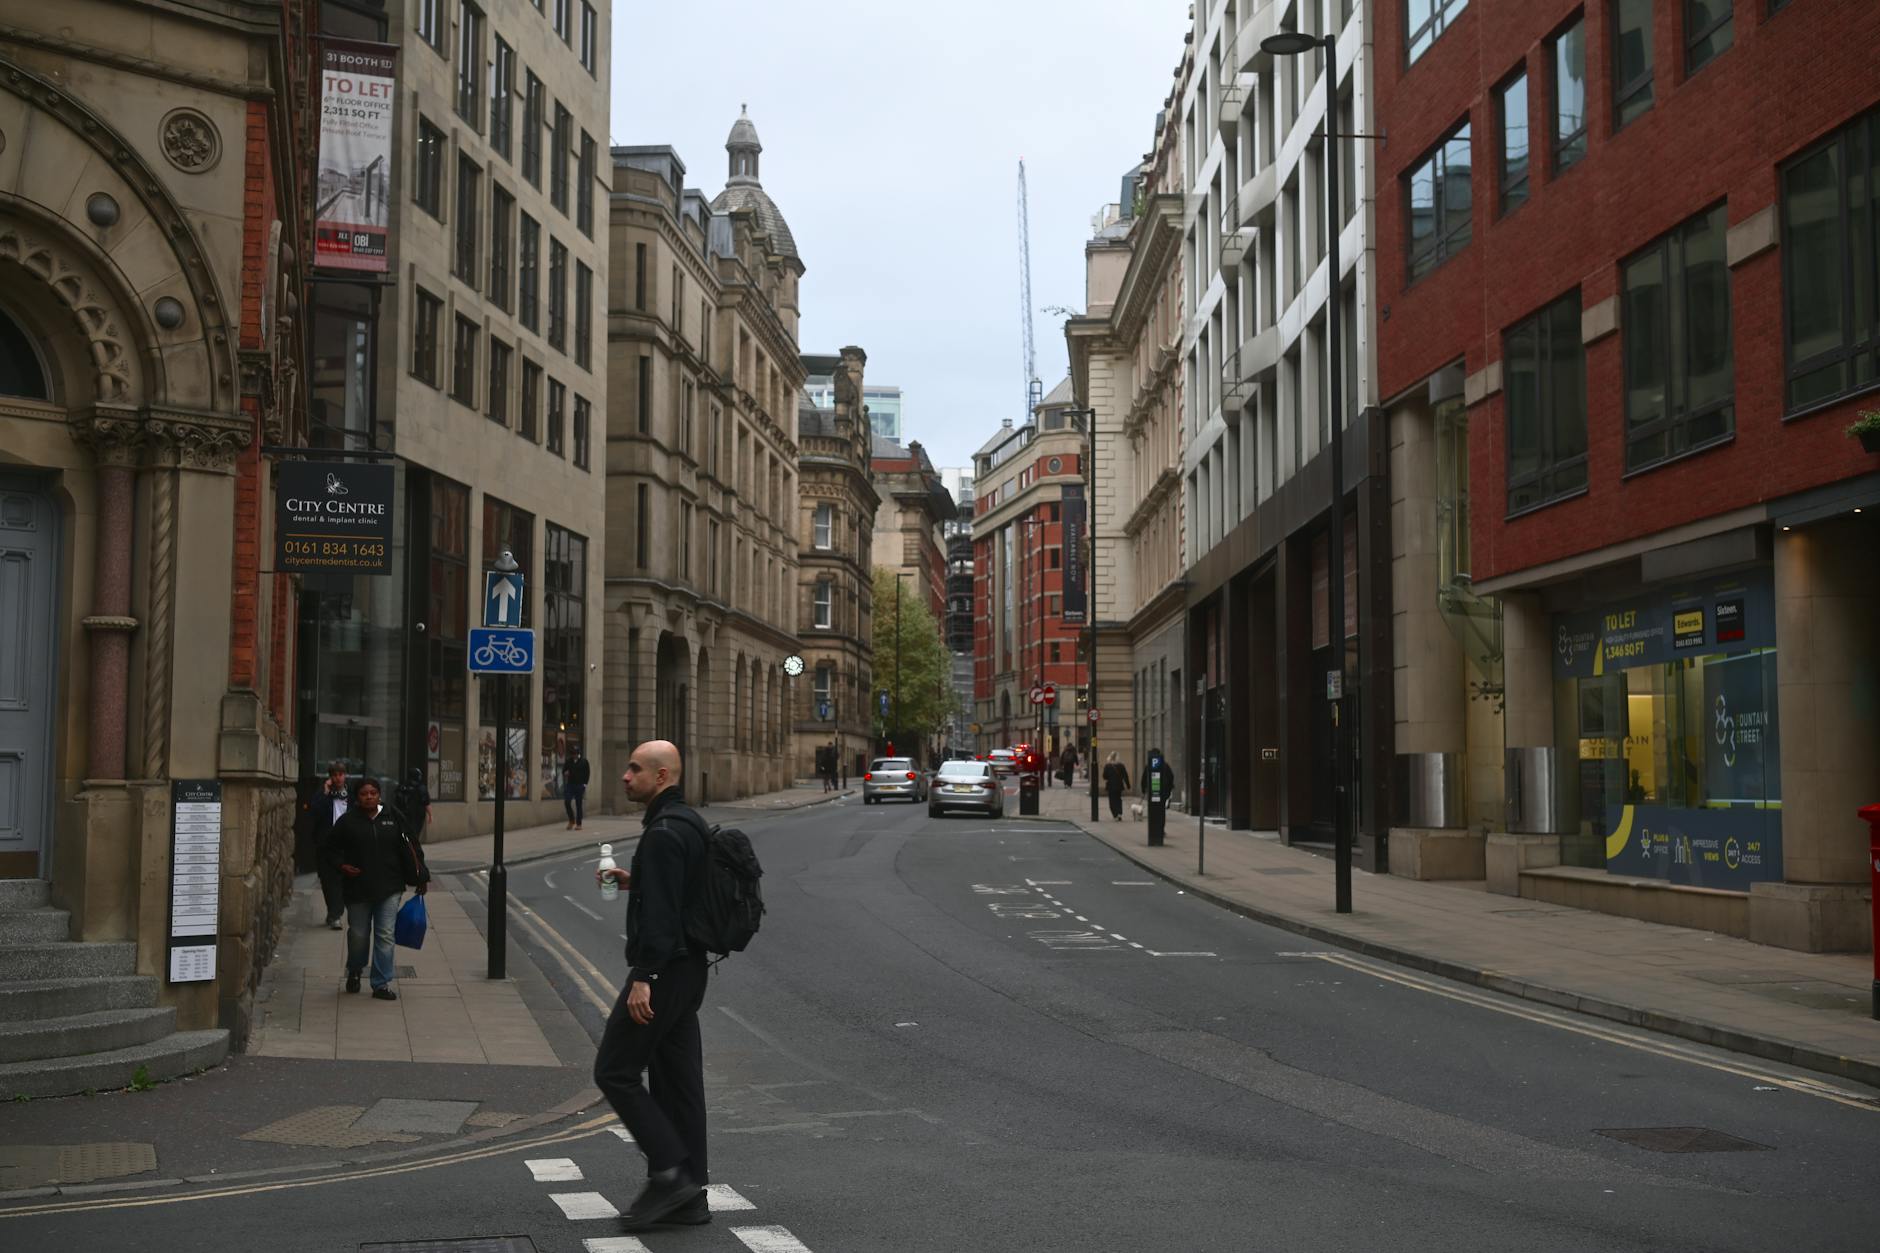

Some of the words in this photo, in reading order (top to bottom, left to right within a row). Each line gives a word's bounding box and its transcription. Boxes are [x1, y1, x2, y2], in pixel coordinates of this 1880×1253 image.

[327, 53, 337, 62] 31
[340, 55, 378, 66] BOOTH
[325, 77, 353, 93] TO
[358, 81, 393, 99] LET
[336, 98, 361, 107] FLOOR
[363, 101, 391, 110] OFFICE
[323, 106, 349, 116] 2,311
[352, 109, 366, 119] SQ
[368, 111, 380, 120] FT
[286, 498, 322, 512] CITY
[326, 500, 385, 515] CENTRE
[292, 514, 317, 522] dental
[327, 515, 356, 525] implant
[358, 516, 378, 525] clinic
[285, 541, 317, 554] 0161
[322, 542, 348, 555] 834
[352, 543, 384, 556] 1643
[284, 556, 384, 568] citycentredentist.co.uk
[1605, 614, 1618, 632] TO
[1619, 610, 1636, 629] LET
[1635, 640, 1645, 654] FT
